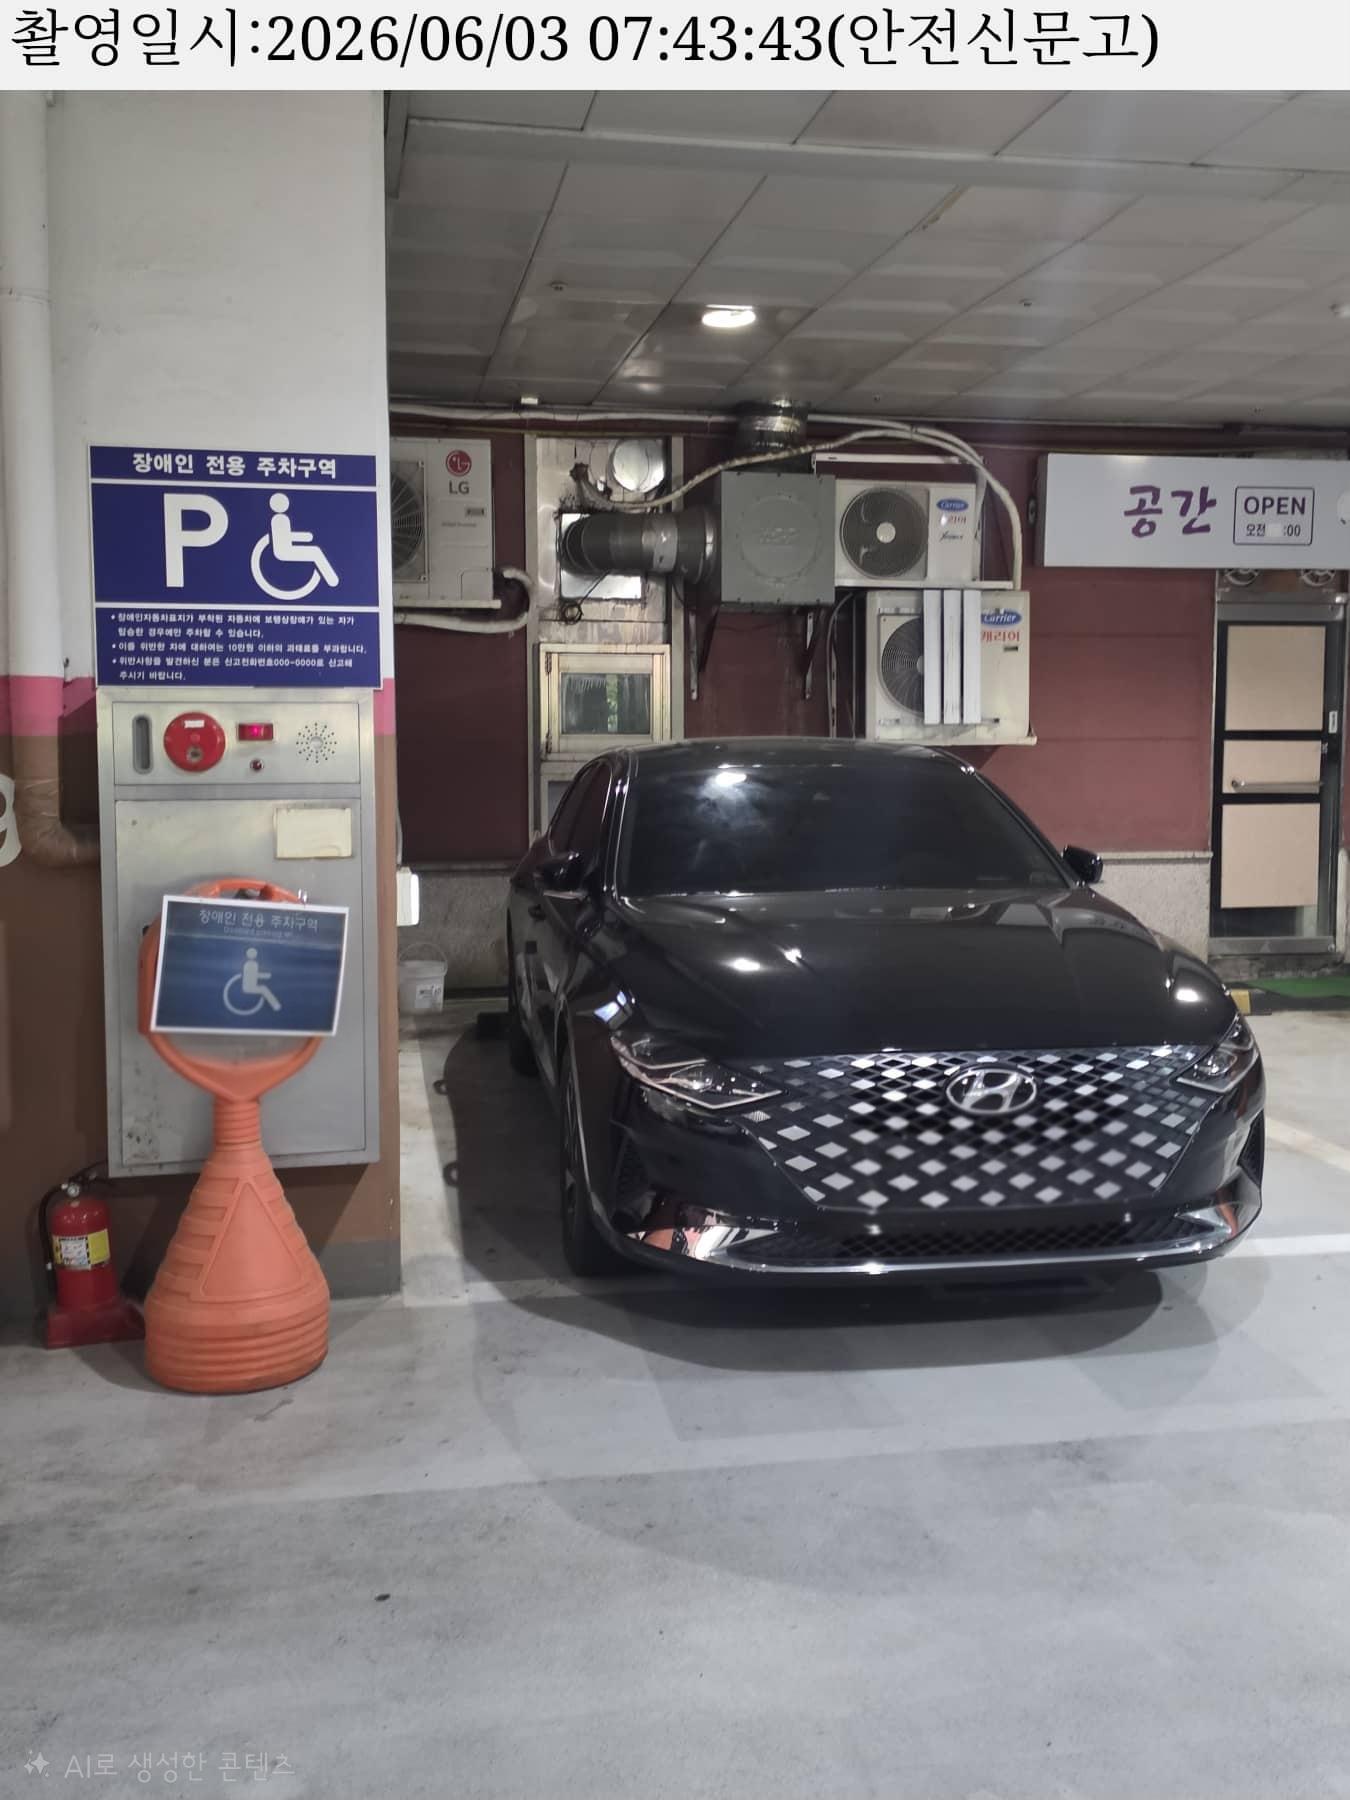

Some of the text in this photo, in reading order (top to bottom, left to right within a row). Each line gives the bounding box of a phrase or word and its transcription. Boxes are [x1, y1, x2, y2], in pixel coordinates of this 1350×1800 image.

[133, 453, 336, 479] 장애인 전용 주차구역
[449, 480, 470, 495] LG
[1124, 486, 1217, 538] 공간
[1244, 496, 1306, 515] OPEN
[1246, 523, 1266, 537] 오전
[163, 493, 229, 588] P
[186, 628, 211, 638] 주차할
[215, 628, 224, 638] 수
[190, 642, 224, 653] 대하여는
[228, 643, 254, 653] 10만원
[119, 671, 145, 681] 주시기
[199, 909, 236, 926] 장애인
[241, 911, 265, 928] 전용
